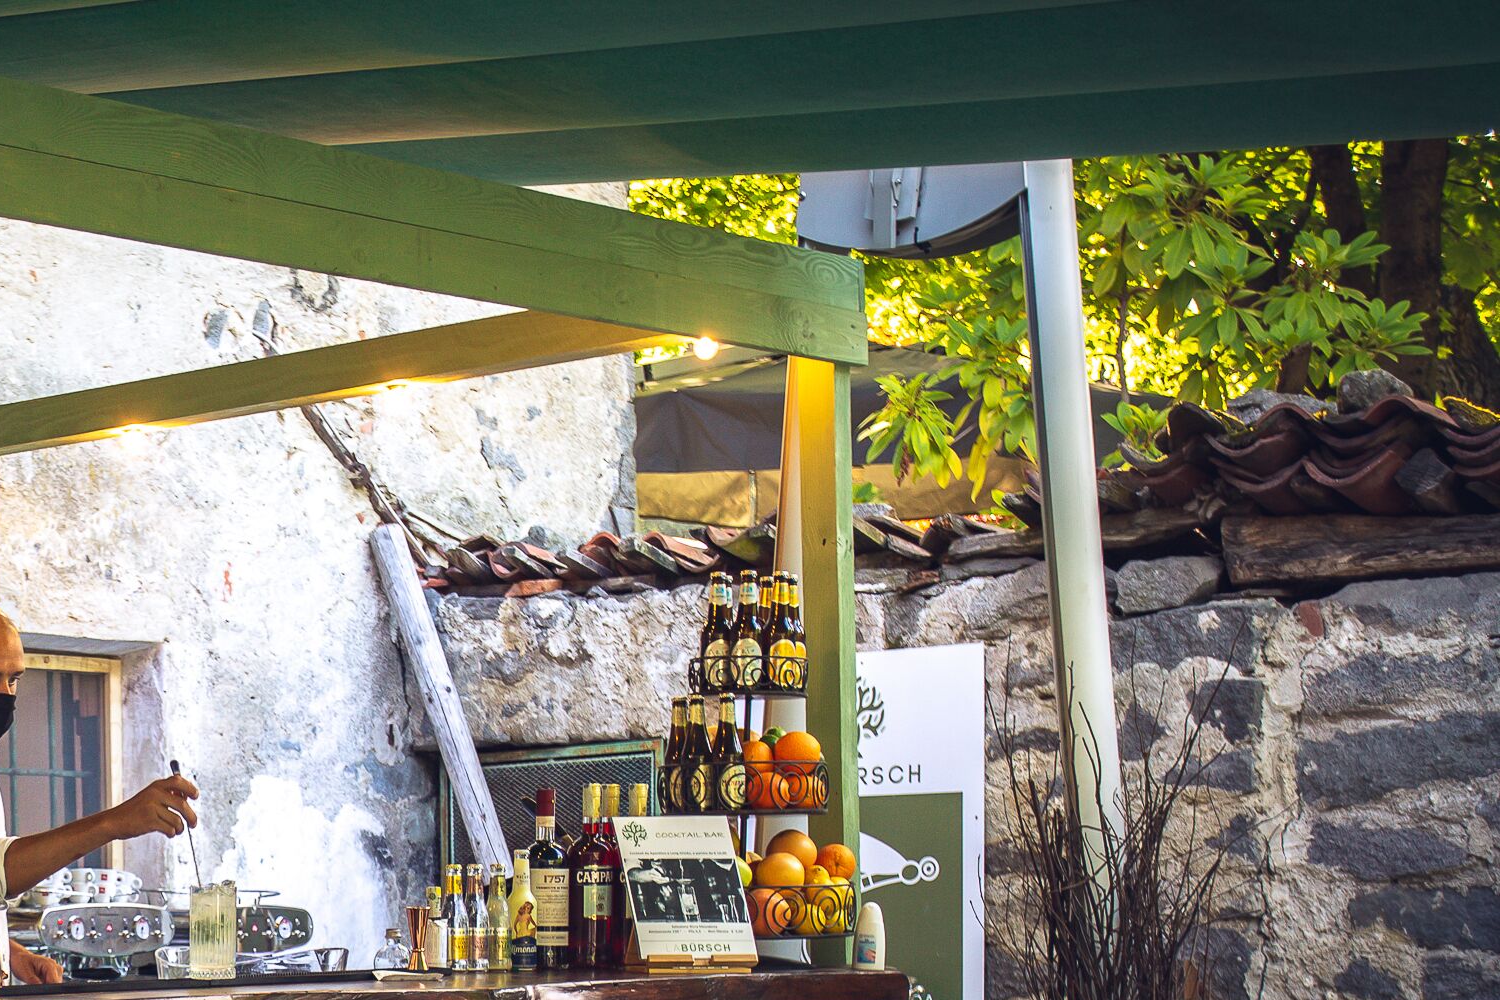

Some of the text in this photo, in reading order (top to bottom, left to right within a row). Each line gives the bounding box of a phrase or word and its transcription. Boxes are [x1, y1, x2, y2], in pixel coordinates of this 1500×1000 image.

[858, 764, 921, 785] RSCH
[655, 831, 700, 839] COCKTAIL
[543, 874, 566, 884] 1757
